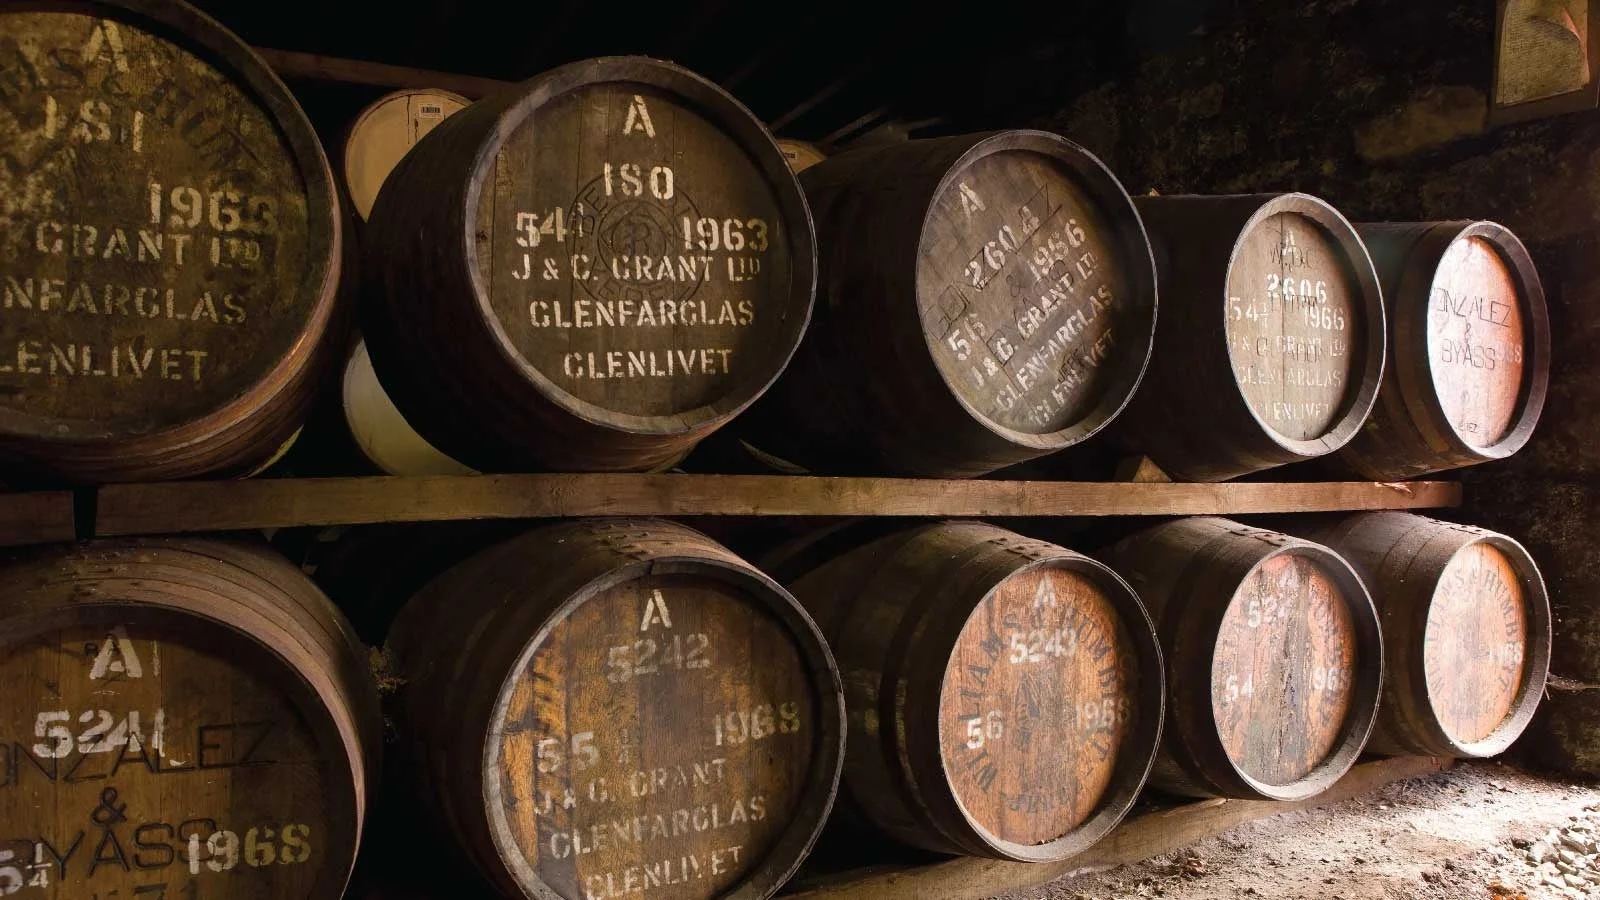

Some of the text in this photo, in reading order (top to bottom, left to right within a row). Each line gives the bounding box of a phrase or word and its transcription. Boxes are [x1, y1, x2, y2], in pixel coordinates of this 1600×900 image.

[80, 19, 130, 73] A
[622, 94, 656, 138] A
[959, 182, 987, 221] A
[683, 216, 769, 252] 1963
[1281, 230, 1297, 256] A
[512, 253, 531, 280] J
[543, 258, 560, 280] &
[613, 256, 714, 281] GRANT
[1267, 273, 1327, 304] 2606
[529, 299, 754, 328] GLENFARGLAS
[1303, 305, 1345, 331] 1966
[564, 349, 733, 379] GLENLIVET
[1441, 338, 1496, 371] BYASS
[1033, 575, 1056, 608] A
[640, 589, 672, 631] A
[90, 625, 143, 680] A
[606, 633, 711, 684] 5242
[91, 786, 128, 827] &
